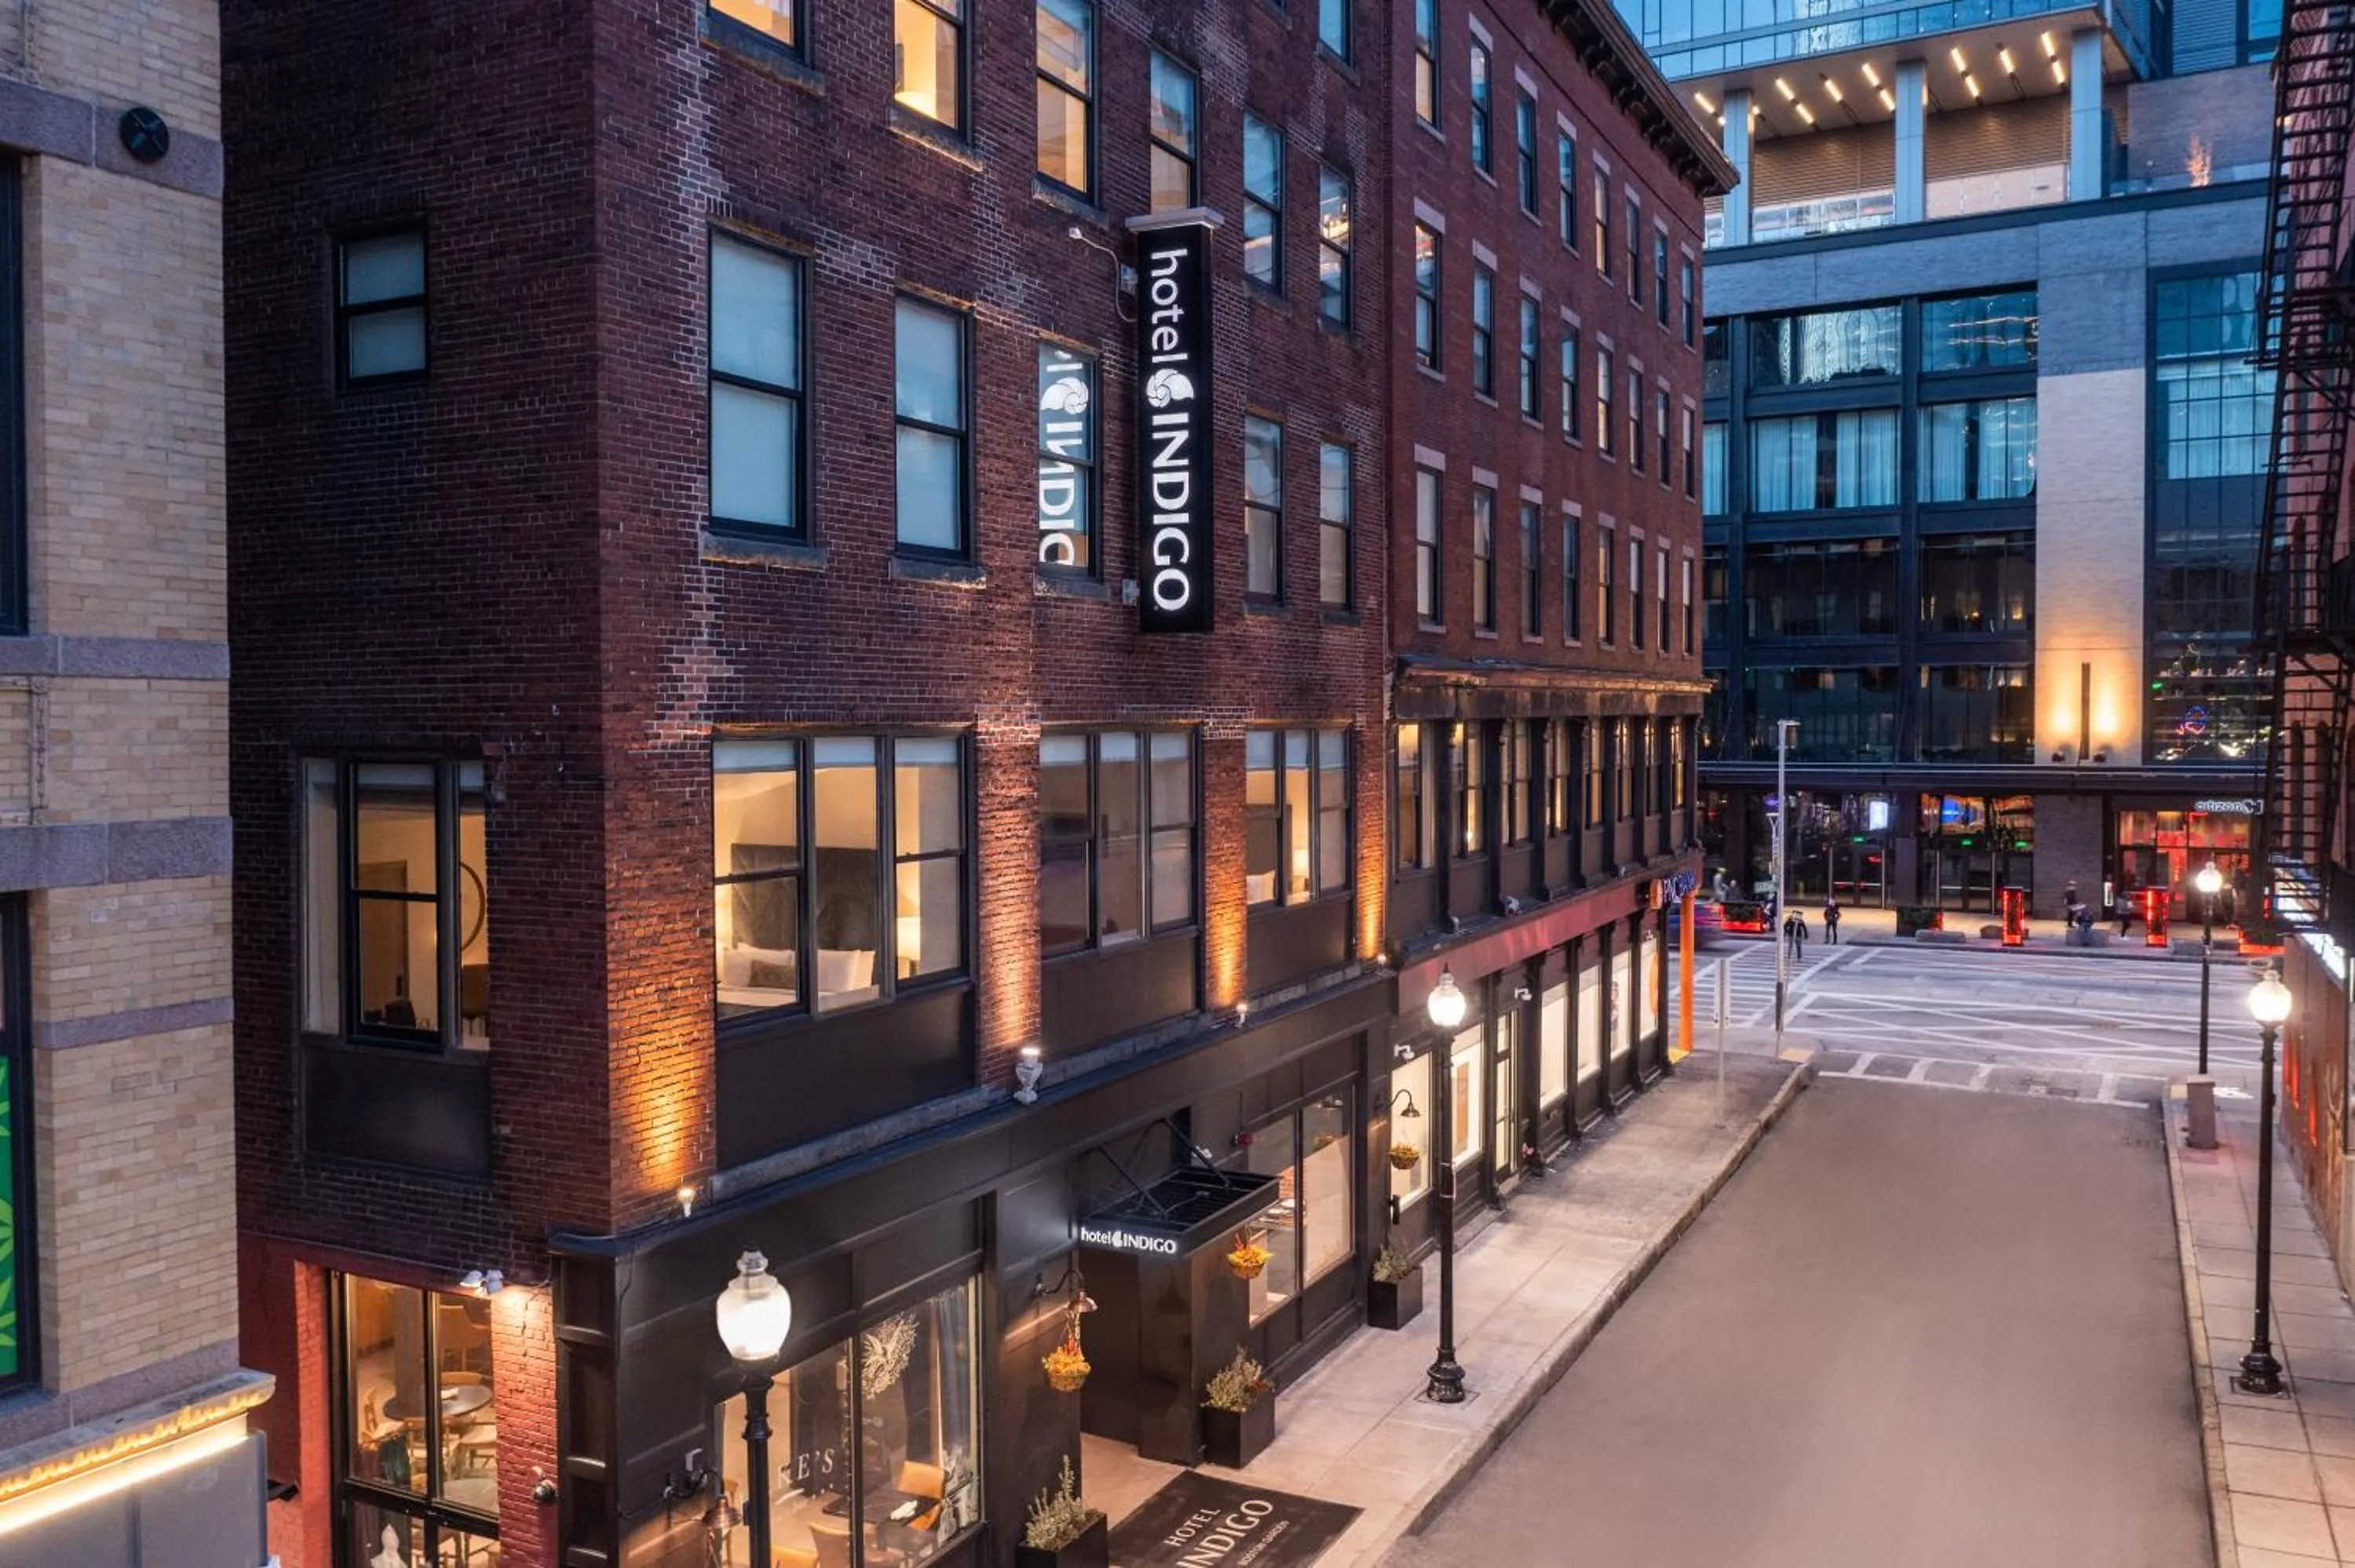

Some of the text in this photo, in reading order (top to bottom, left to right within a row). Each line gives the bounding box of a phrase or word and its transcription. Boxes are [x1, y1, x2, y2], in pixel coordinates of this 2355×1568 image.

[1151, 249, 1190, 611] hotel INDIGO
[1080, 1227, 1177, 1253] hotel INDIGO
[1163, 1508, 1221, 1547] HOTEL
